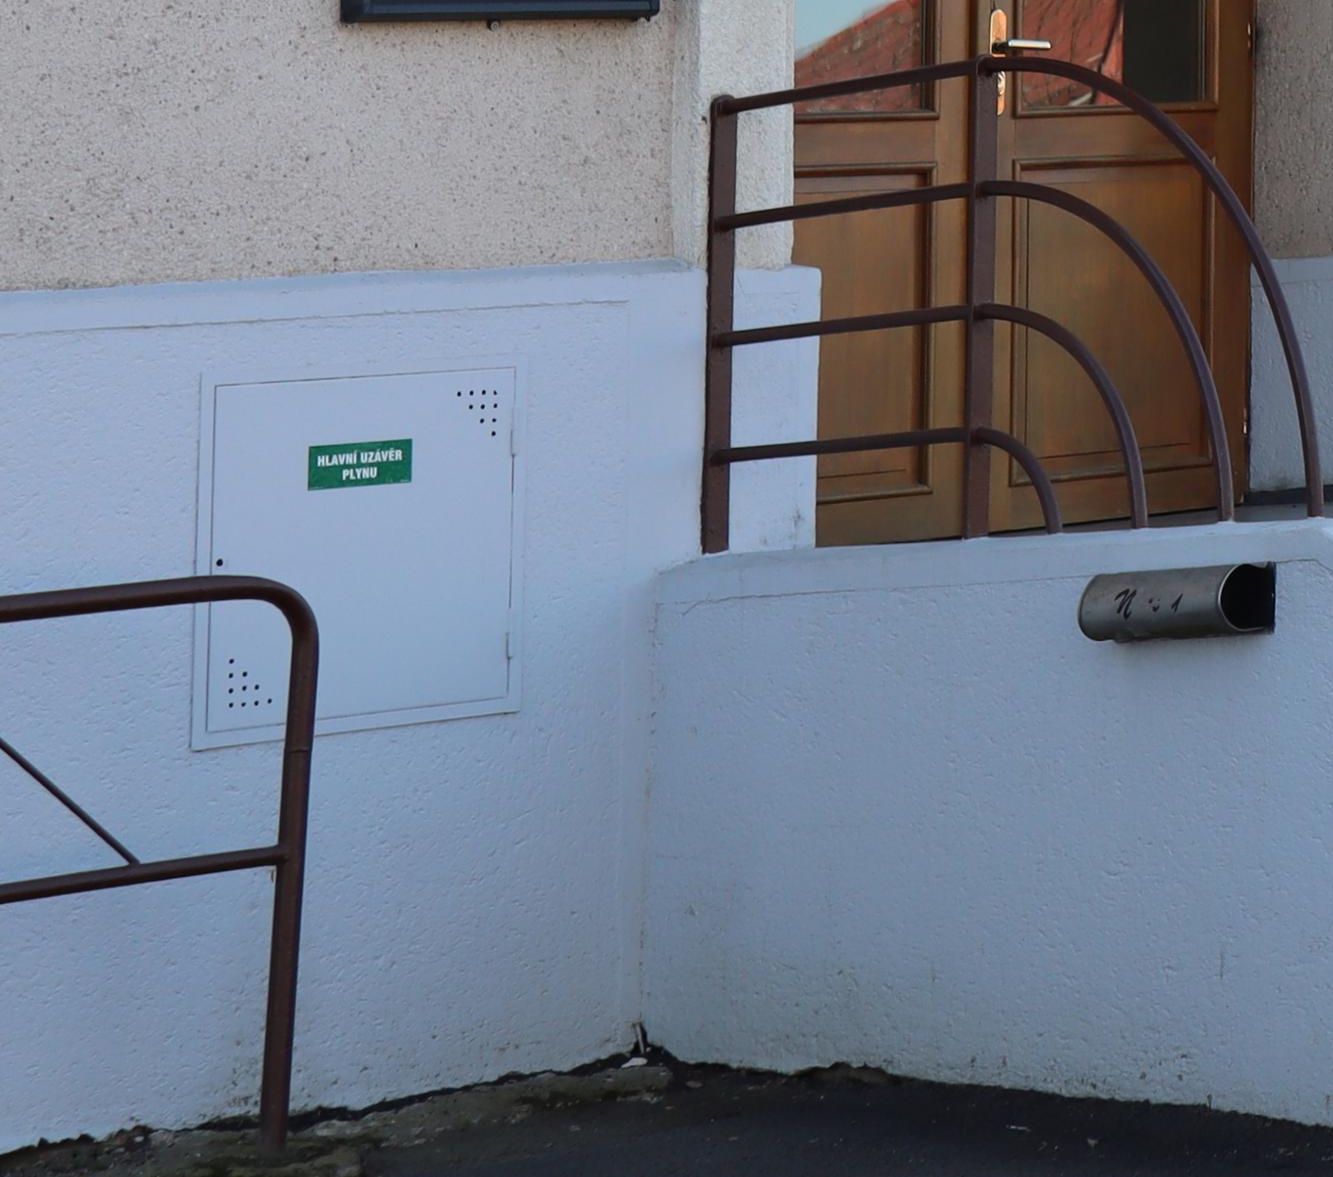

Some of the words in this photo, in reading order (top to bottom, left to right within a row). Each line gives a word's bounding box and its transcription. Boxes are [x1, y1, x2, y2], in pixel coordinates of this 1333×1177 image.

[317, 449, 358, 467] HLAVNÍ
[360, 448, 403, 464] UZÁVĚR
[342, 467, 378, 481] PLYNU
